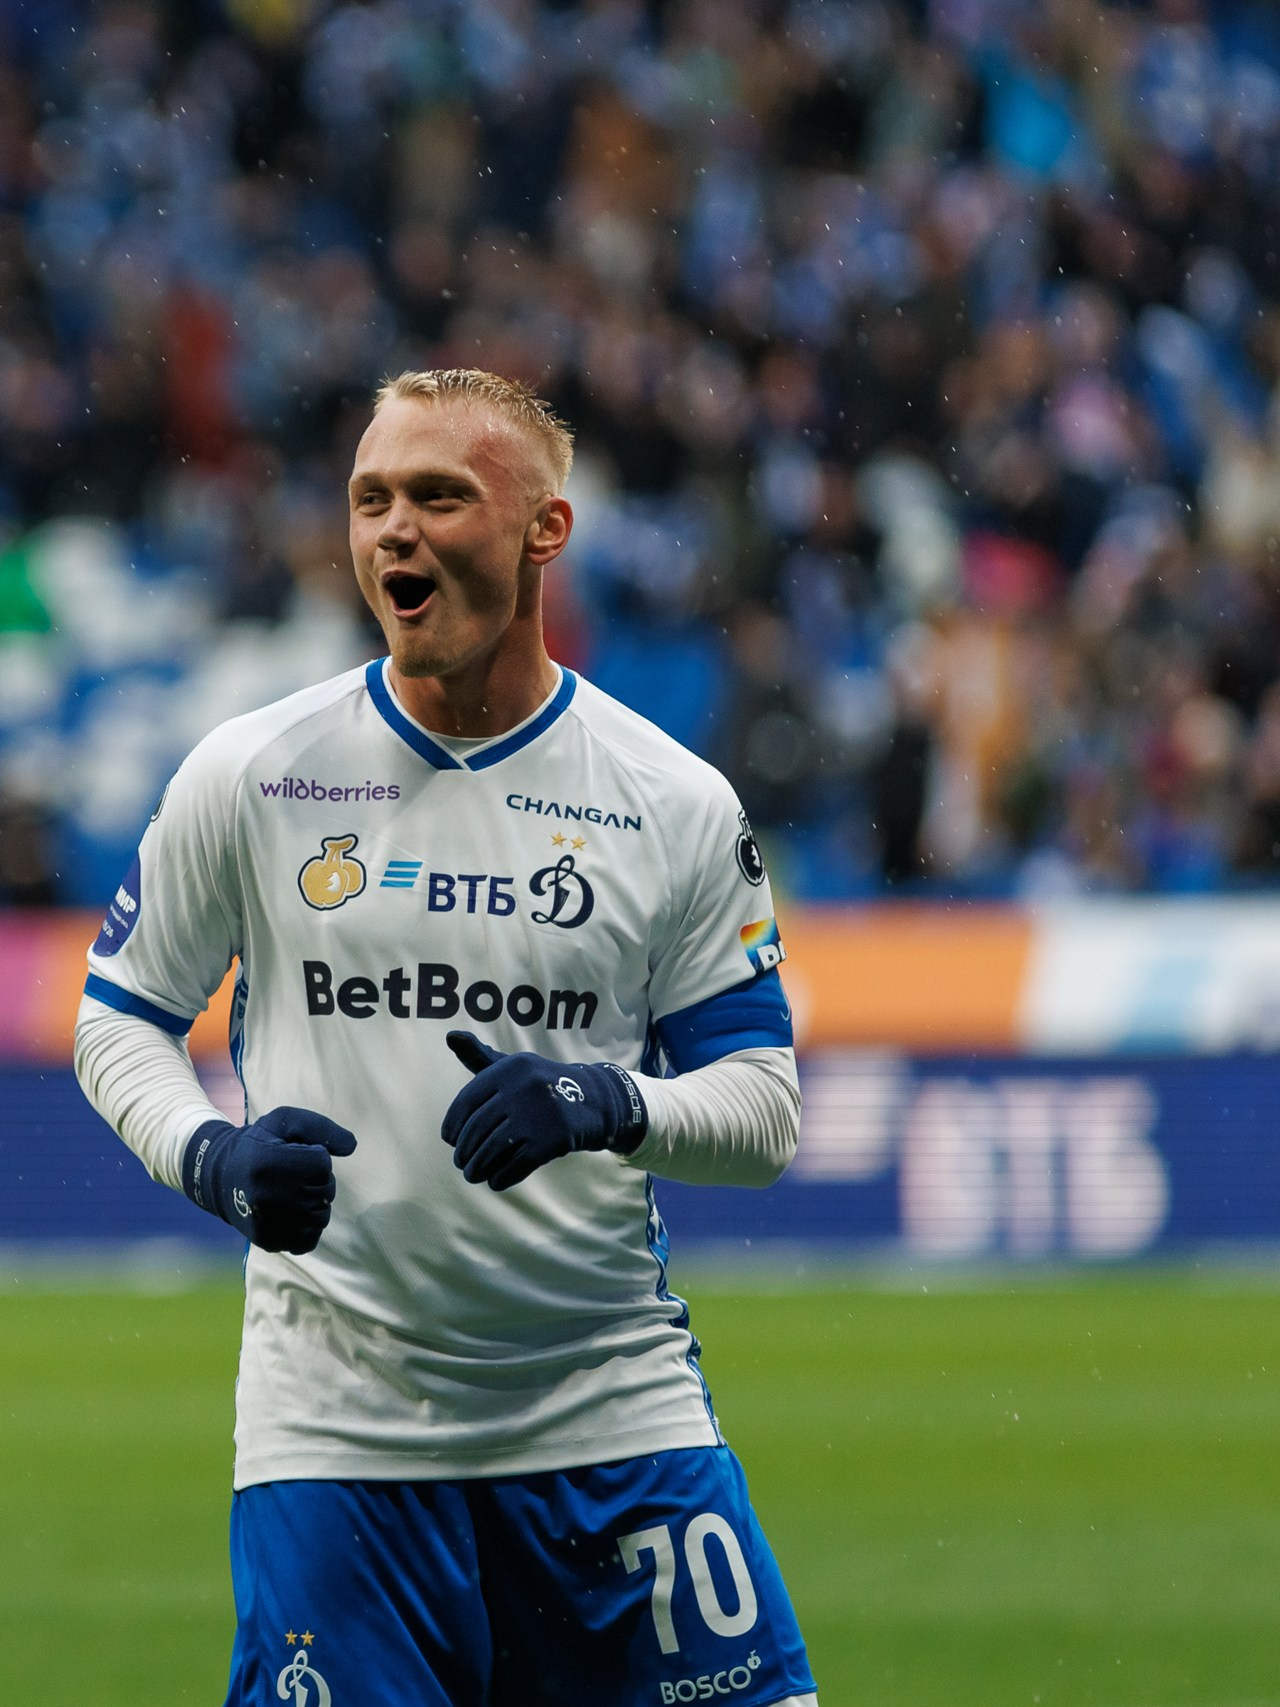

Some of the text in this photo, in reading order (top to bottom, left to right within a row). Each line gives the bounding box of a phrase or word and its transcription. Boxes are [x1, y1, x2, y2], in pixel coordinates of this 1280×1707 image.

[260, 777, 401, 802] wildberries
[506, 793, 642, 832] CHANGAN
[427, 872, 517, 917] ВТБ
[302, 960, 599, 1031] BetBoom
[616, 1512, 758, 1655] 70
[660, 1666, 752, 1705] BOSCO
